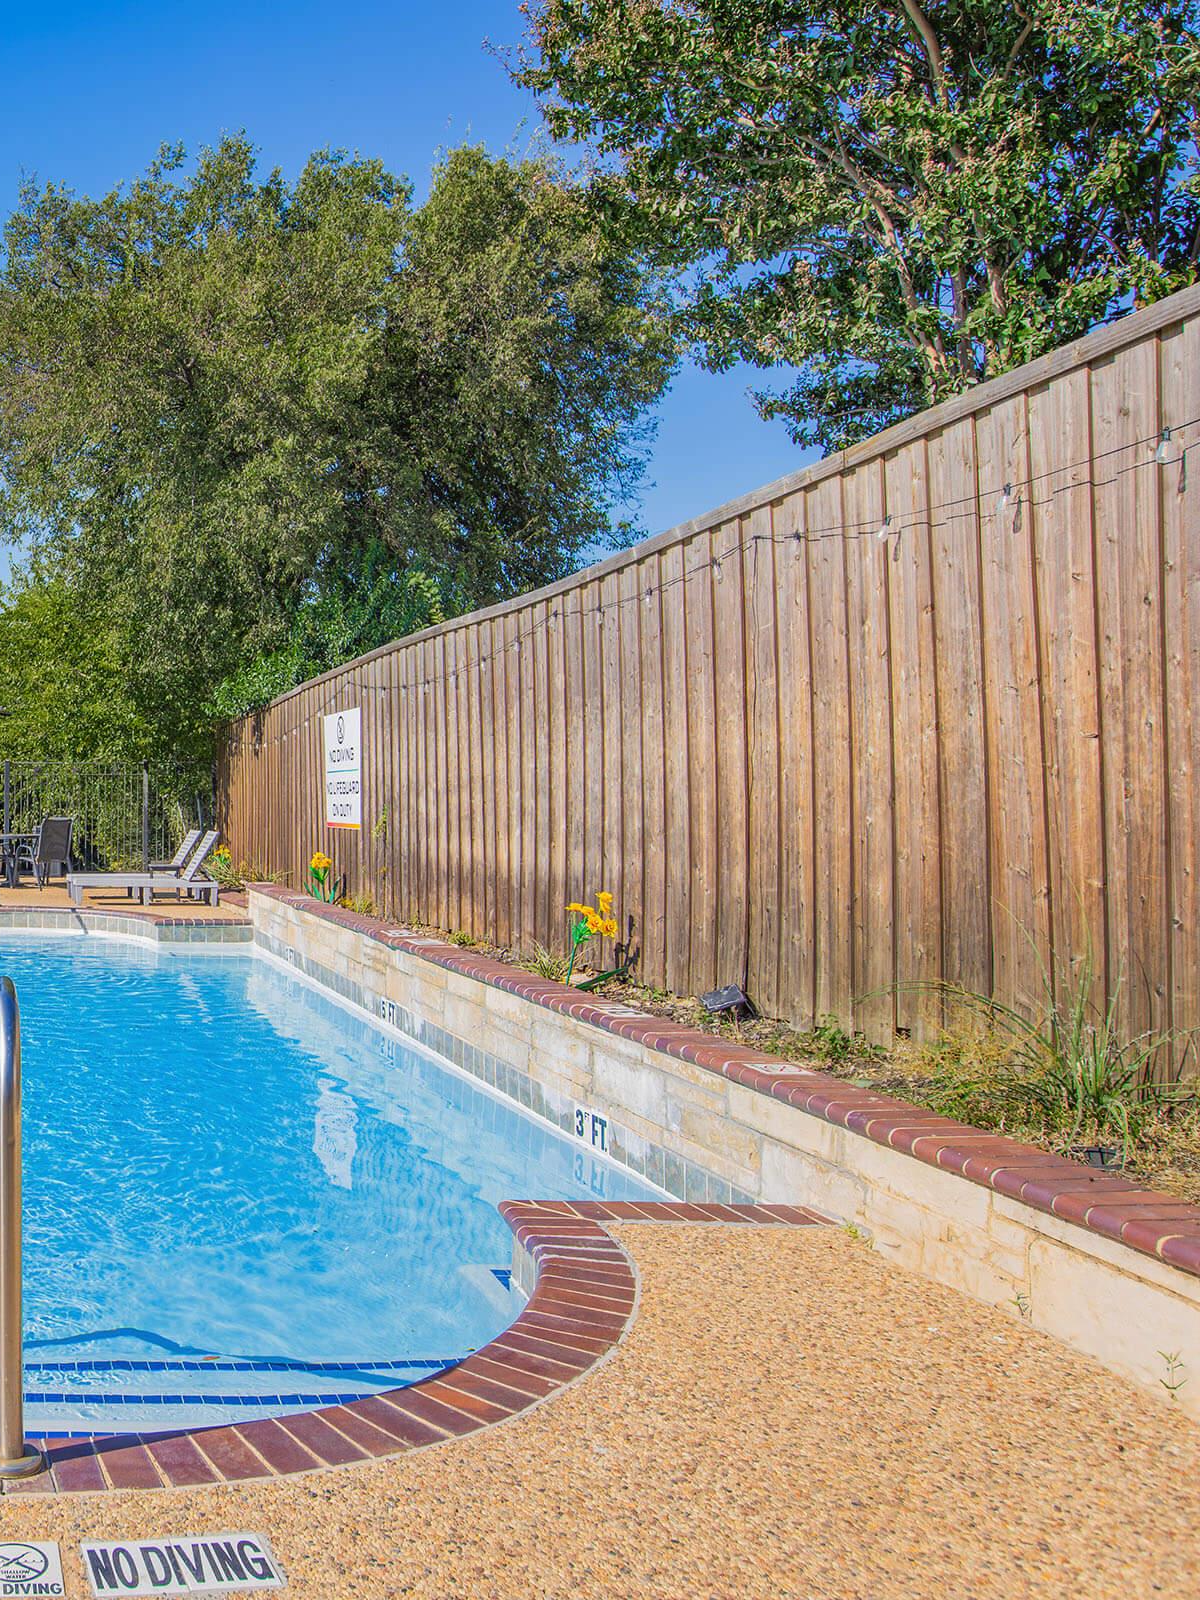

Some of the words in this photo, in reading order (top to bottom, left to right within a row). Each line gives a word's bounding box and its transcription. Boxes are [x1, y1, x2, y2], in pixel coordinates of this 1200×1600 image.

[575, 1109, 584, 1137] 3
[86, 1547, 140, 1590] NO
[139, 1539, 276, 1588] DIVING
[3, 1583, 63, 1595] DIVING
